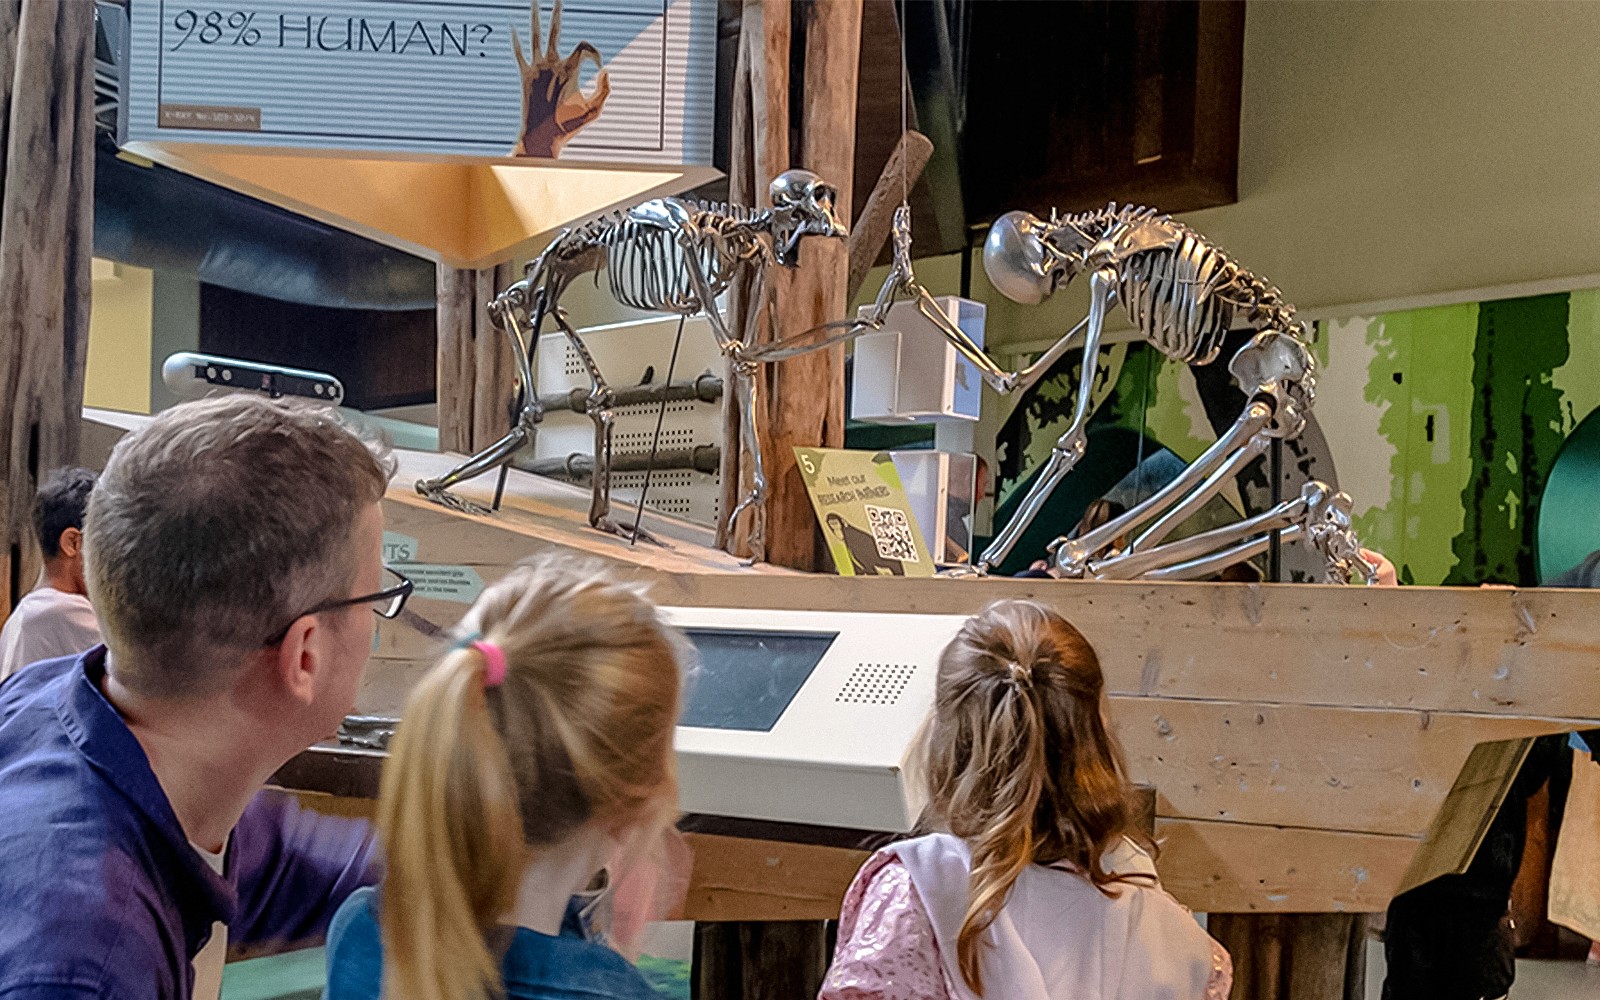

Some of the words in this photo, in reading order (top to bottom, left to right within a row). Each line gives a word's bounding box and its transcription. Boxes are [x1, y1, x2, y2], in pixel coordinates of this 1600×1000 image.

[171, 9, 262, 52] 98%
[276, 14, 493, 57] HUMAN?
[800, 454, 815, 474] 5
[826, 475, 850, 487] Meet
[851, 474, 866, 484] our
[817, 489, 857, 506] RESEARCH
[854, 485, 890, 501] PARTNERS
